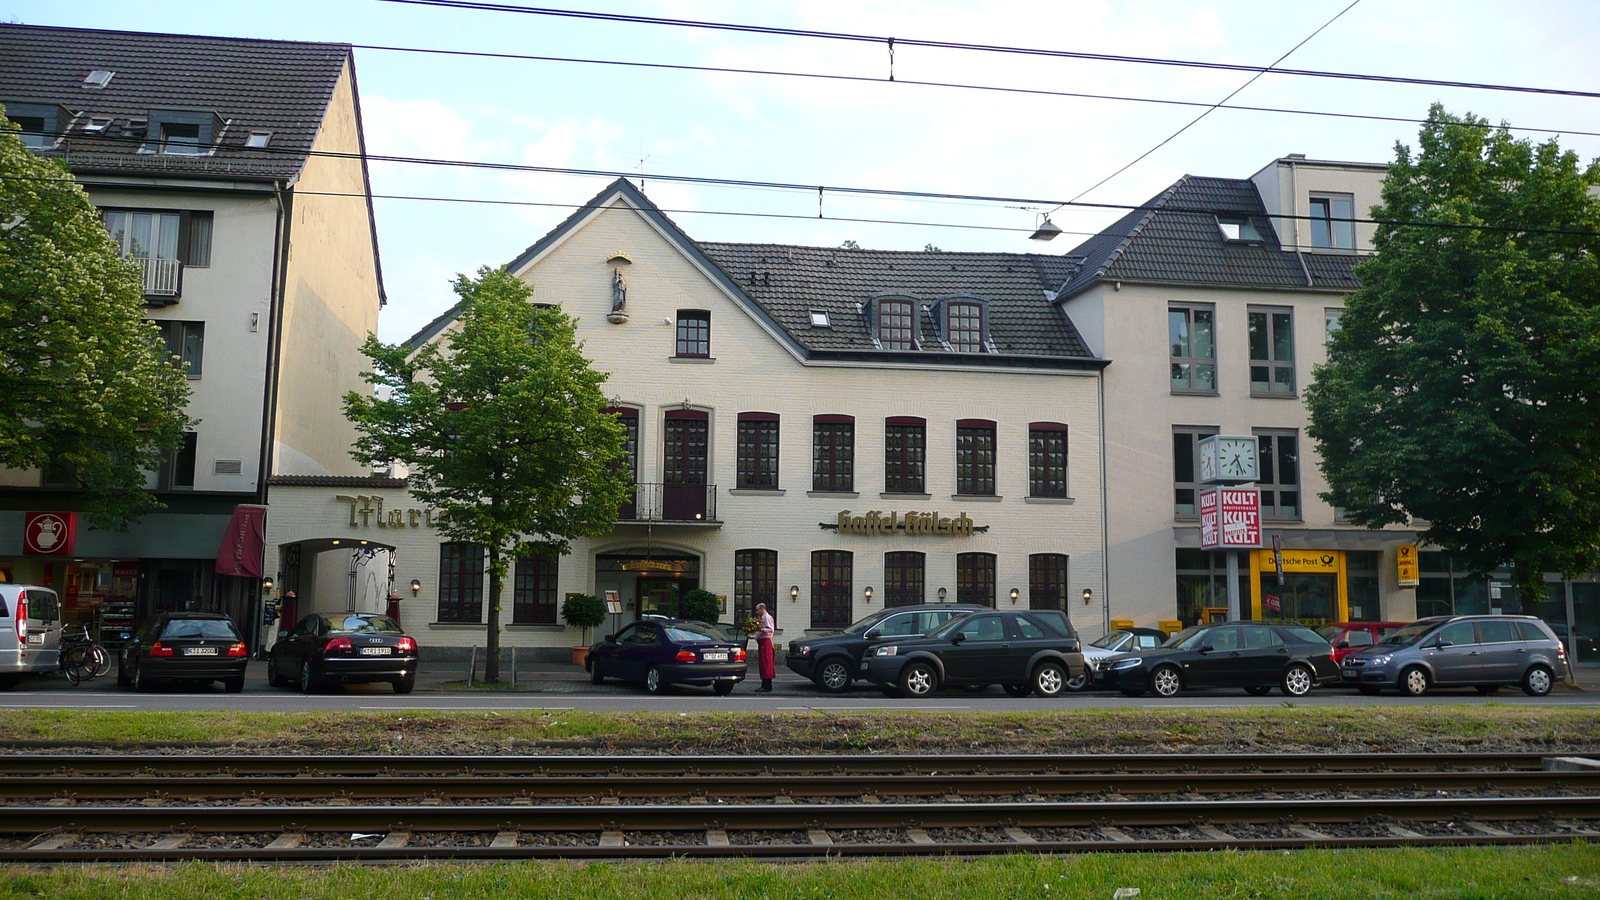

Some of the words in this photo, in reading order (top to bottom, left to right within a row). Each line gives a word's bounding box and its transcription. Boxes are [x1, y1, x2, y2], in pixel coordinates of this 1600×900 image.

[1201, 492, 1216, 508] KULT
[1222, 491, 1256, 505] KULT
[838, 509, 974, 536] Gaffel-Kölsch
[1223, 511, 1257, 525] KULT
[1224, 531, 1258, 544] KULT
[1302, 557, 1318, 565] Post
